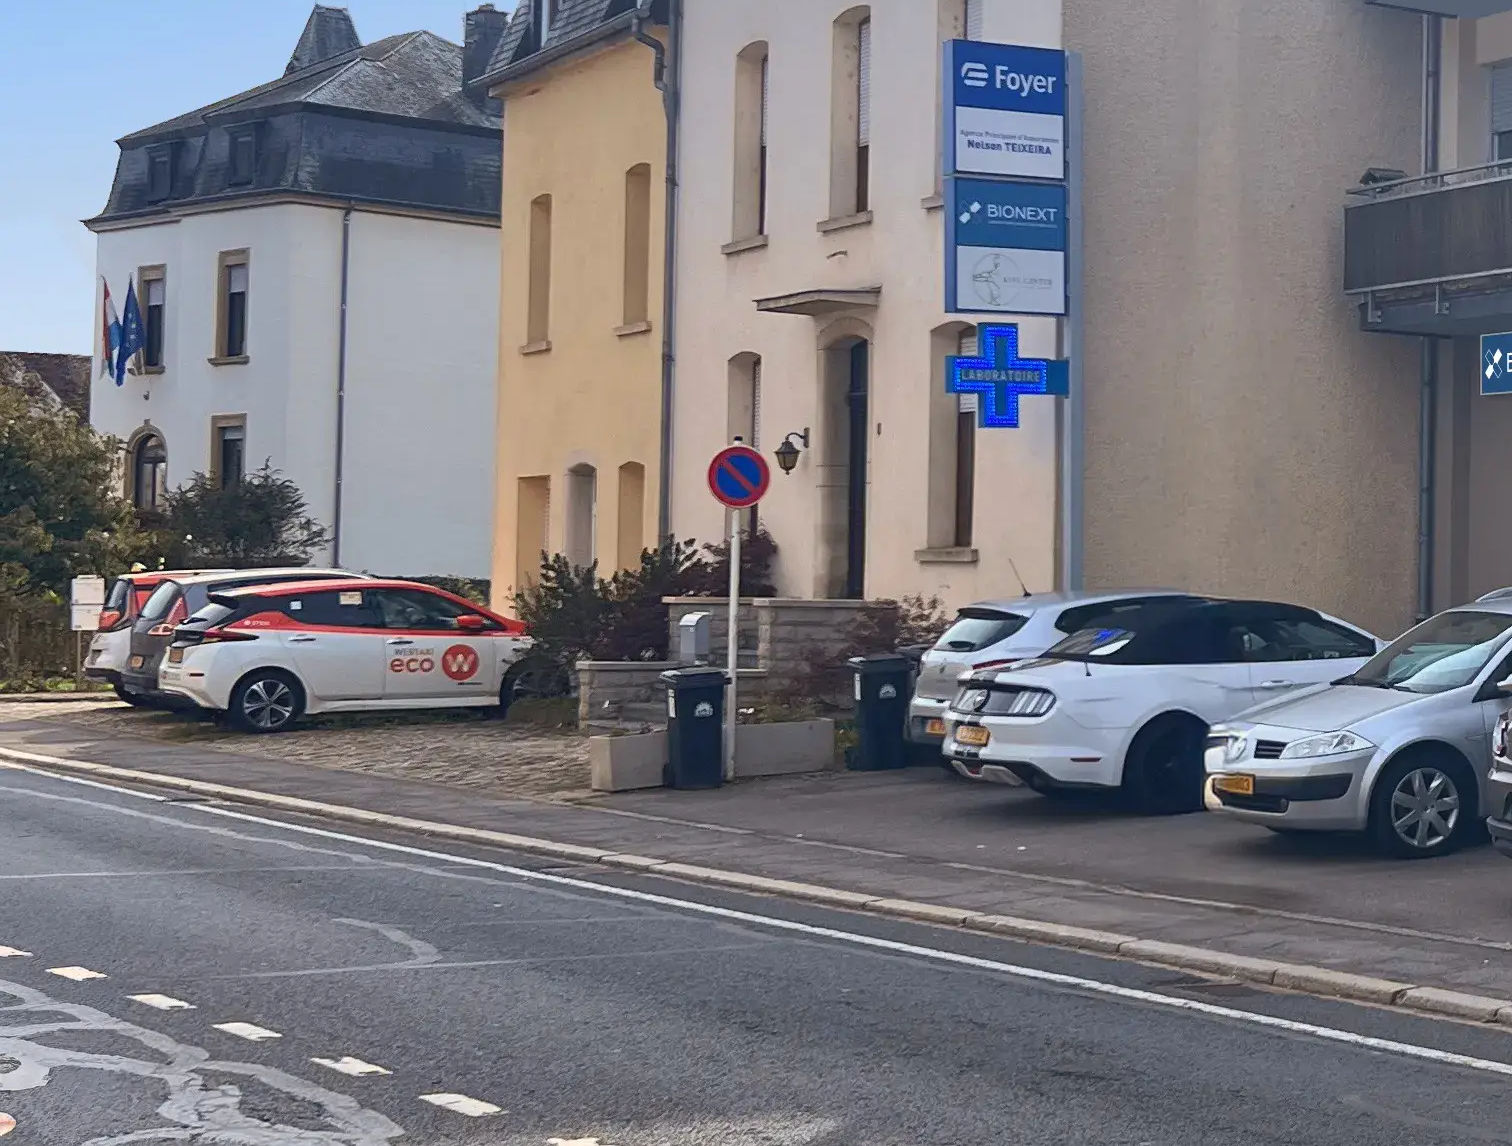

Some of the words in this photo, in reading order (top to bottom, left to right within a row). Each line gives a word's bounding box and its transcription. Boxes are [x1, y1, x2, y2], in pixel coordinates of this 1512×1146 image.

[995, 65, 1057, 97] Foyer
[967, 139, 1002, 152] Nelson
[1005, 142, 1052, 155] TEIXEIRA
[987, 203, 1058, 222] BIONEXT
[390, 658, 435, 673] eco
